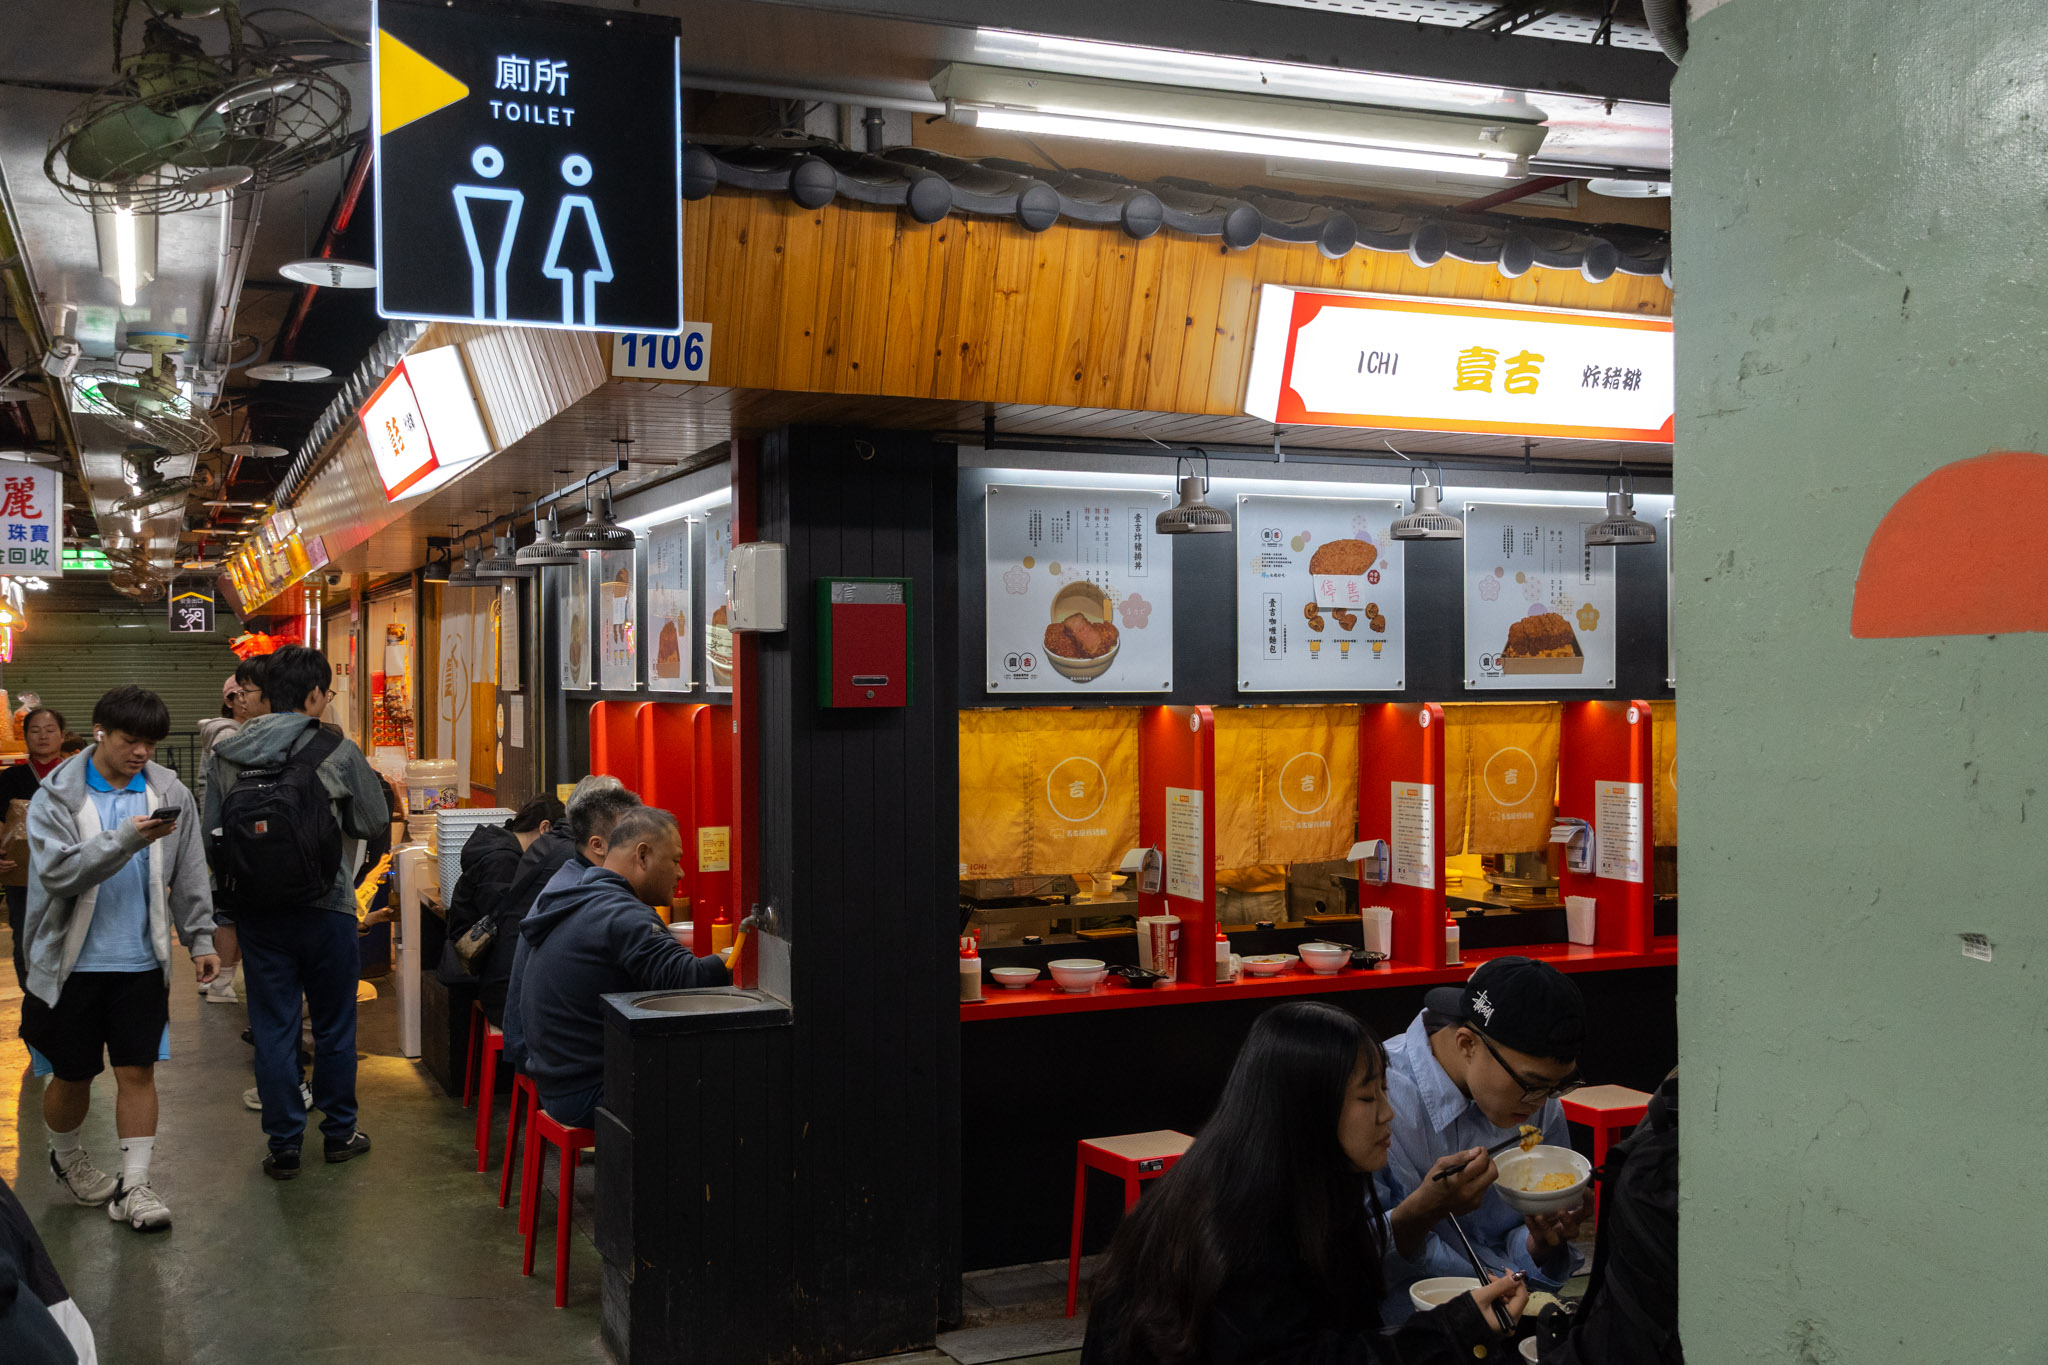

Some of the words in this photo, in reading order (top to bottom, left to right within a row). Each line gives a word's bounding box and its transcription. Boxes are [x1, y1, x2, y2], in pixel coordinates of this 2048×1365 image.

[495, 54, 570, 97] 廁所
[489, 100, 576, 128] TOILET
[621, 331, 705, 372] 1106
[1357, 351, 1399, 376] ICHI
[1453, 346, 1545, 395] 壹吉
[1581, 365, 1643, 392] 炸豬排
[0, 475, 43, 520] 麗
[8, 523, 50, 543] 珠寶
[1320, 579, 1360, 603] 停售
[1191, 717, 1197, 729] 5
[1421, 713, 1427, 724] 6
[1629, 711, 1635, 720] 7
[969, 863, 988, 871] ICHI
